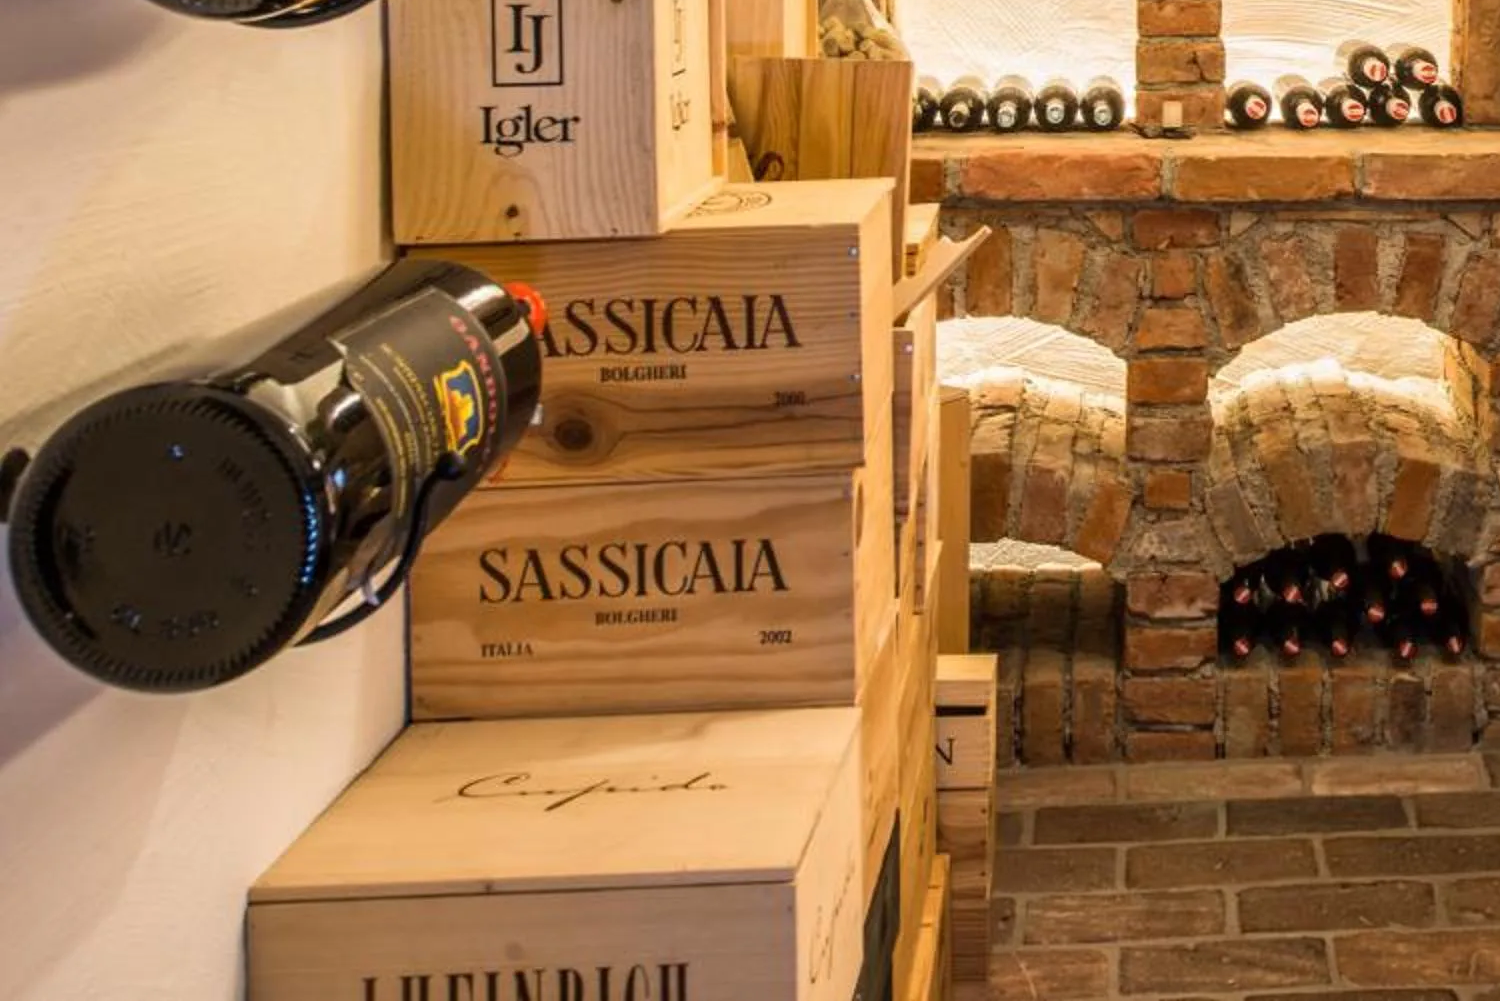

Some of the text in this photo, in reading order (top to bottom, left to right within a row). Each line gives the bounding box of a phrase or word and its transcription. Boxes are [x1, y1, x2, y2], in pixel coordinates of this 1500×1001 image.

[479, 103, 581, 158] Igler
[538, 294, 802, 358] ASSICAIA
[599, 365, 687, 383] BOLGHERI
[479, 539, 789, 604] SASSICAIA
[594, 608, 678, 626] BOLGHERI
[758, 630, 793, 645] 2002
[480, 643, 534, 659] ITALIA
